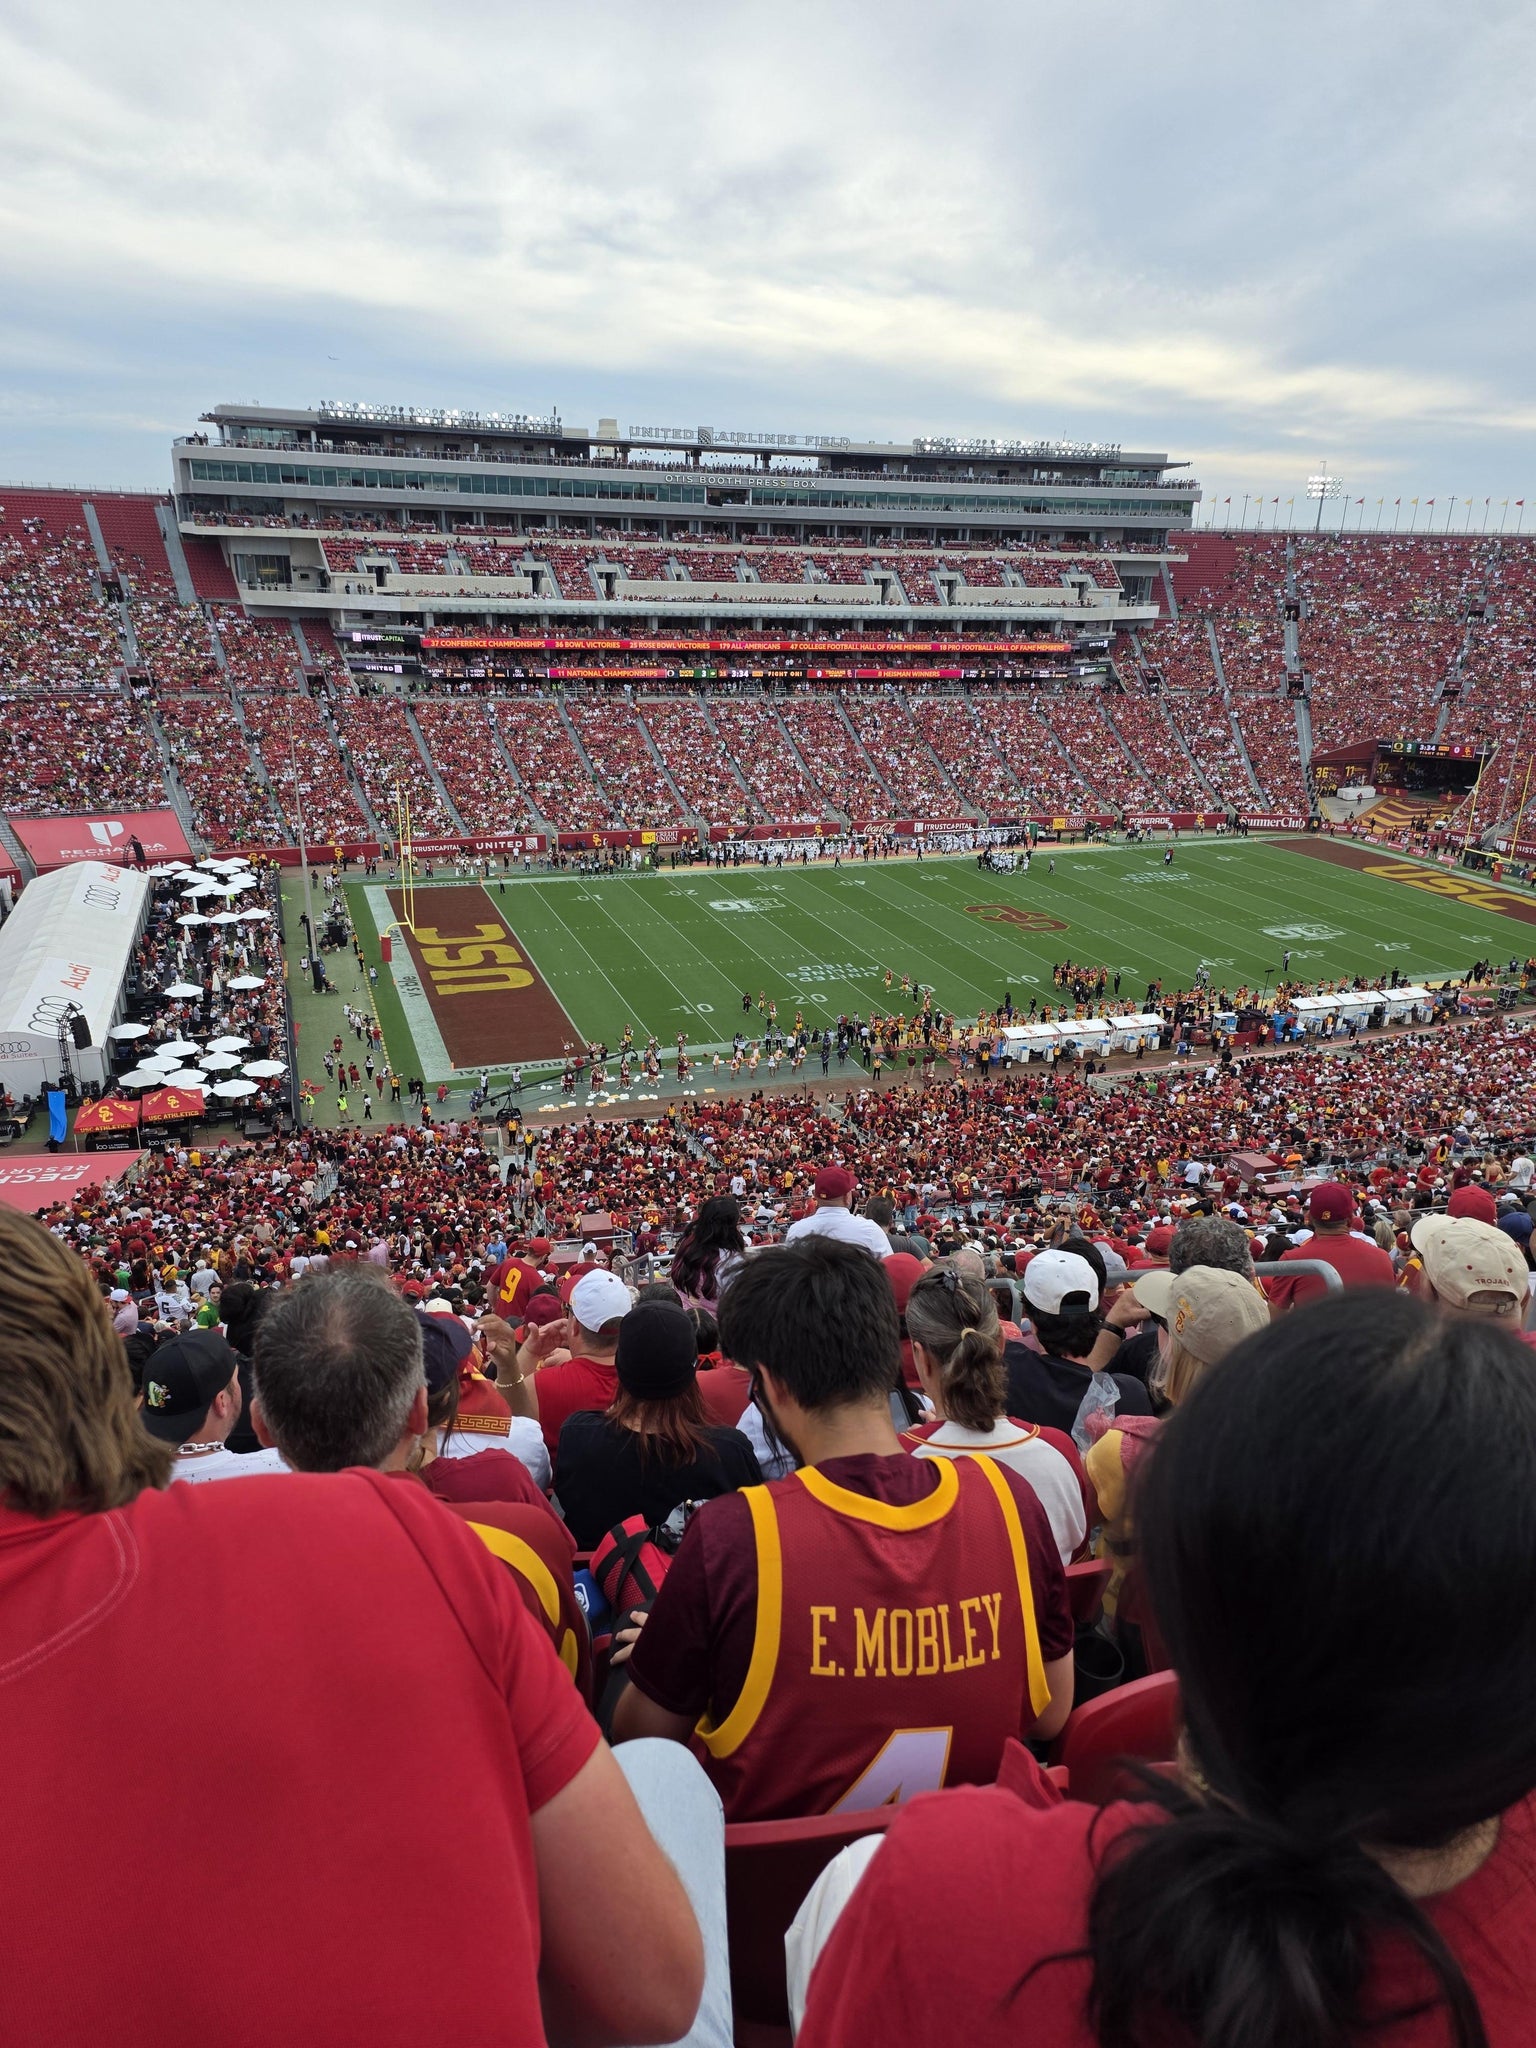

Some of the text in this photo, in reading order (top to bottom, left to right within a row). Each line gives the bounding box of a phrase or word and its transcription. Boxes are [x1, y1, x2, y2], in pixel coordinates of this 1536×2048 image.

[629, 426, 851, 448] UNITED AIRLINES FIELD
[665, 474, 817, 488] OTIS BOOTH PRESS BOX
[488, 640, 546, 648] CHAMPIONSHIPS
[731, 670, 749, 678] 3:34
[1315, 767, 1329, 779] 36
[1129, 817, 1171, 825] POWERADE
[864, 823, 896, 835] Coca-Cola
[476, 840, 523, 849] UNITED
[414, 924, 535, 996] USC
[60, 963, 92, 991] Audi
[1007, 974, 1041, 985] 40
[791, 993, 829, 1005] 20
[679, 1003, 715, 1015] 10
[163, 1110, 200, 1120] ATHLETICS
[95, 1123, 132, 1132] ATHLETICS
[962, 1185, 969, 1195] 5
[648, 1216, 659, 1224] 24
[1081, 1214, 1093, 1229] 14
[501, 1267, 522, 1303] 9
[161, 1302, 170, 1315] 6
